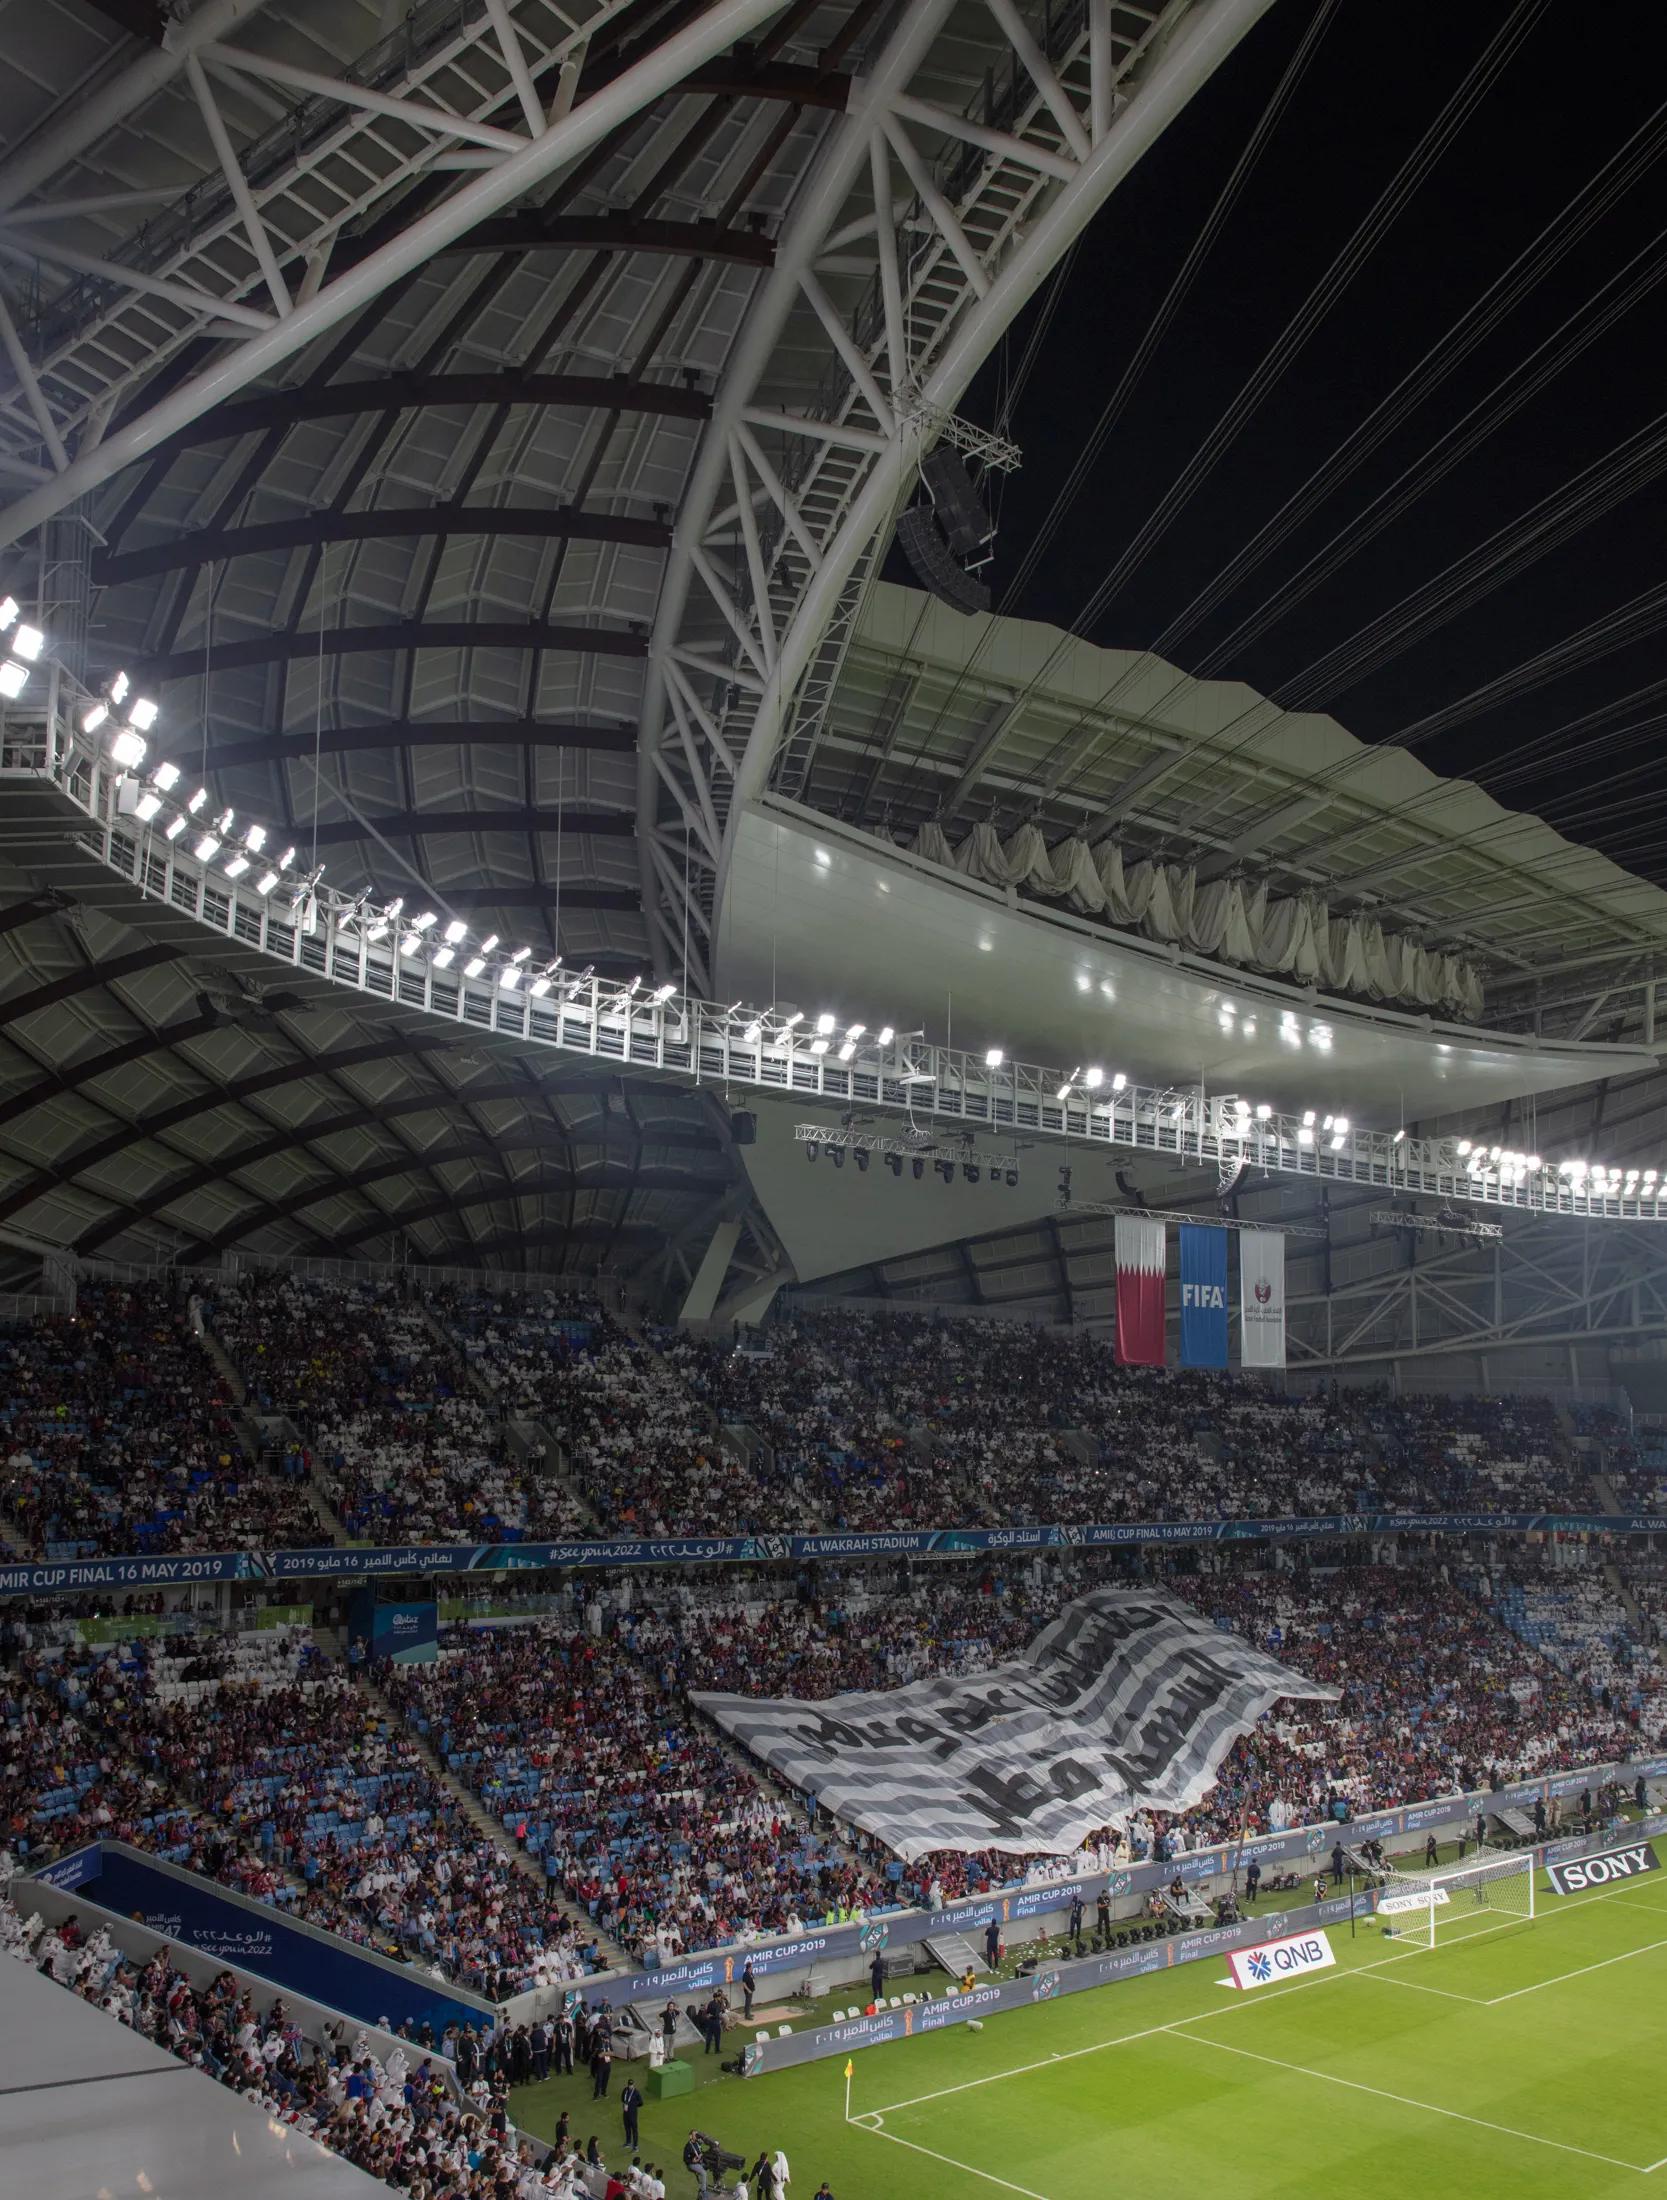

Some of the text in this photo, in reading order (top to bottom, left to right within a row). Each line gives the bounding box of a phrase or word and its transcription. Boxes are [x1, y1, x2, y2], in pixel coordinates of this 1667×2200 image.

[1182, 1283, 1224, 1309] FIFA
[1630, 1520, 1646, 1529] AL
[988, 1529, 1040, 1546] استاد الوكرة
[1117, 1528, 1135, 1539] CUP
[1136, 1528, 1160, 1539] FINAL
[1162, 1528, 1172, 1537] 16
[1173, 1527, 1191, 1537] MAY
[1192, 1526, 1213, 1536] 2019
[802, 1537, 919, 1552] AL WAKRAH STADIUM
[283, 1557, 315, 1569] 2019
[317, 1556, 341, 1571] مايو
[344, 1556, 359, 1567] 16
[33, 1569, 66, 1586] CUP
[69, 1567, 114, 1584] FINAL
[118, 1564, 137, 1580] 16
[141, 1563, 178, 1579] MAY
[182, 1560, 223, 1577] 2019
[1424, 1809, 1436, 1817] CUP
[1253, 1845, 1267, 1854] CUP
[1268, 1841, 1285, 1851] 2019
[1563, 1848, 1650, 1890] SONY
[1017, 1885, 1081, 1906] AMIR CUP 2019
[1017, 1905, 1035, 1916] Final
[1386, 1899, 1413, 1910] SONY
[1181, 1928, 1241, 1950] AMIR CUP 2019
[744, 1939, 826, 1965] AMIR CUP 2019
[1180, 1949, 1198, 1960] Final
[1274, 1940, 1323, 1970] QNB
[923, 1989, 1000, 2016] AMIR CUP 2019
[922, 2015, 945, 2029] Final
